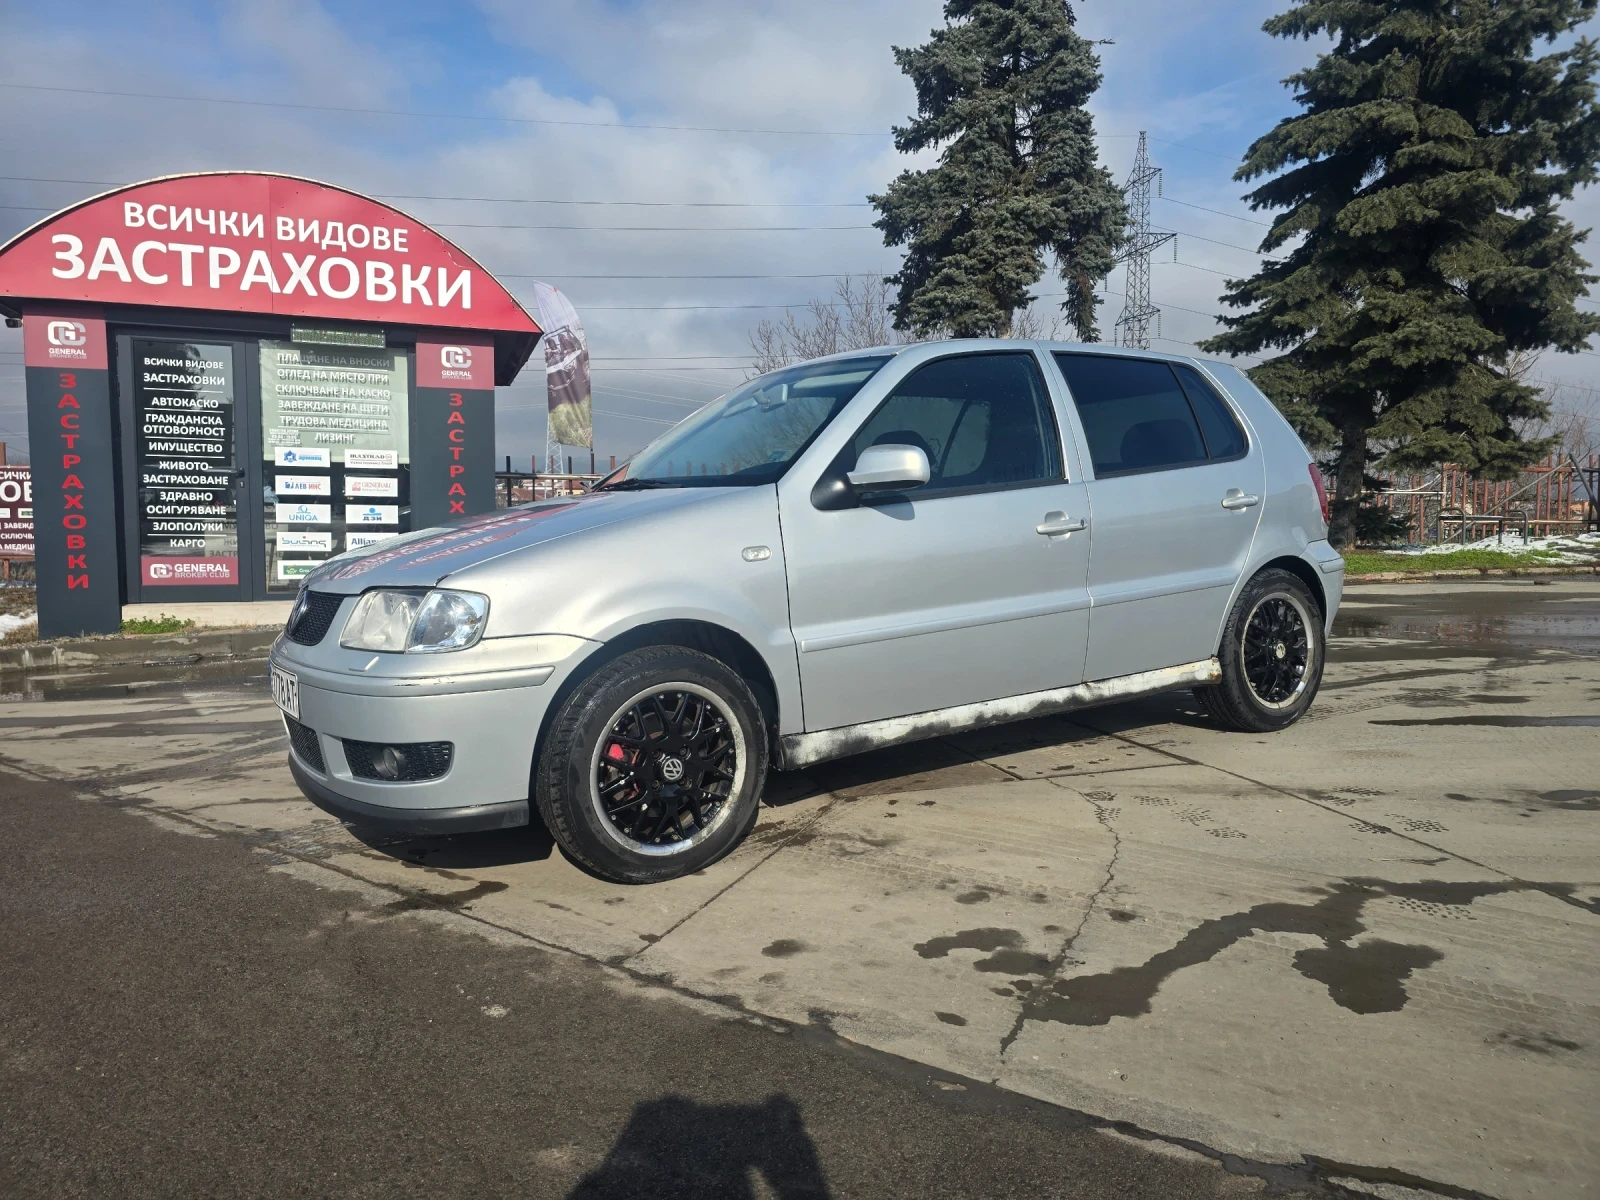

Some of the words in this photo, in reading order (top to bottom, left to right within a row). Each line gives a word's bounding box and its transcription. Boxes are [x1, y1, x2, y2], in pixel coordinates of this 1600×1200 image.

[124, 201, 265, 239] ВСИЧКИ
[276, 216, 409, 253] ВИДОВЕ
[51, 233, 472, 309] ЗАСТРАХОВКИ
[49, 347, 87, 355] GENERAL
[144, 357, 183, 367] ВСИЧКИ
[186, 360, 224, 369] ВИДОВЕ
[332, 356, 346, 364] НА
[350, 357, 390, 367] ВНОСКИ
[144, 372, 225, 386] ЗАСТРАХОВКИ
[277, 369, 310, 380] ОГЛЕД
[313, 370, 327, 380] НА
[330, 371, 365, 381] МЯСТО
[368, 373, 388, 382] ПРИ
[276, 384, 339, 396] СКЛЮЧВАНЕ
[342, 387, 356, 396] НА
[358, 388, 390, 397] КАСКО
[152, 397, 218, 408] АВТОКАСКО
[278, 400, 340, 412] ЗАВЕЖДАНЕ
[343, 402, 357, 412] НА
[360, 403, 388, 412] ЩЕТИ
[146, 414, 222, 426] ГРАЖДАНСКА
[280, 416, 326, 426] ТРУДОВА
[328, 417, 388, 428] МЕДИЦИНА
[144, 425, 226, 436] ОТГОВОРНОСТ
[314, 432, 354, 441] ЛИЗИНГ
[148, 442, 222, 453] ИМУЩЕСТВО
[158, 461, 212, 470] ЖИВОТО-
[58, 373, 88, 589] ЗАСТРАХОВКИ
[143, 474, 228, 485] ЗАСТРАХОВАНЕ
[308, 482, 321, 490] ИНС
[160, 492, 213, 502] ЗДРАВНО
[146, 505, 226, 515] ОСИГУРЯВАНЕ
[152, 522, 223, 532] ЗЛОПОЛУКИ
[170, 539, 206, 548] КАРГО
[174, 564, 230, 572] GENERAL
